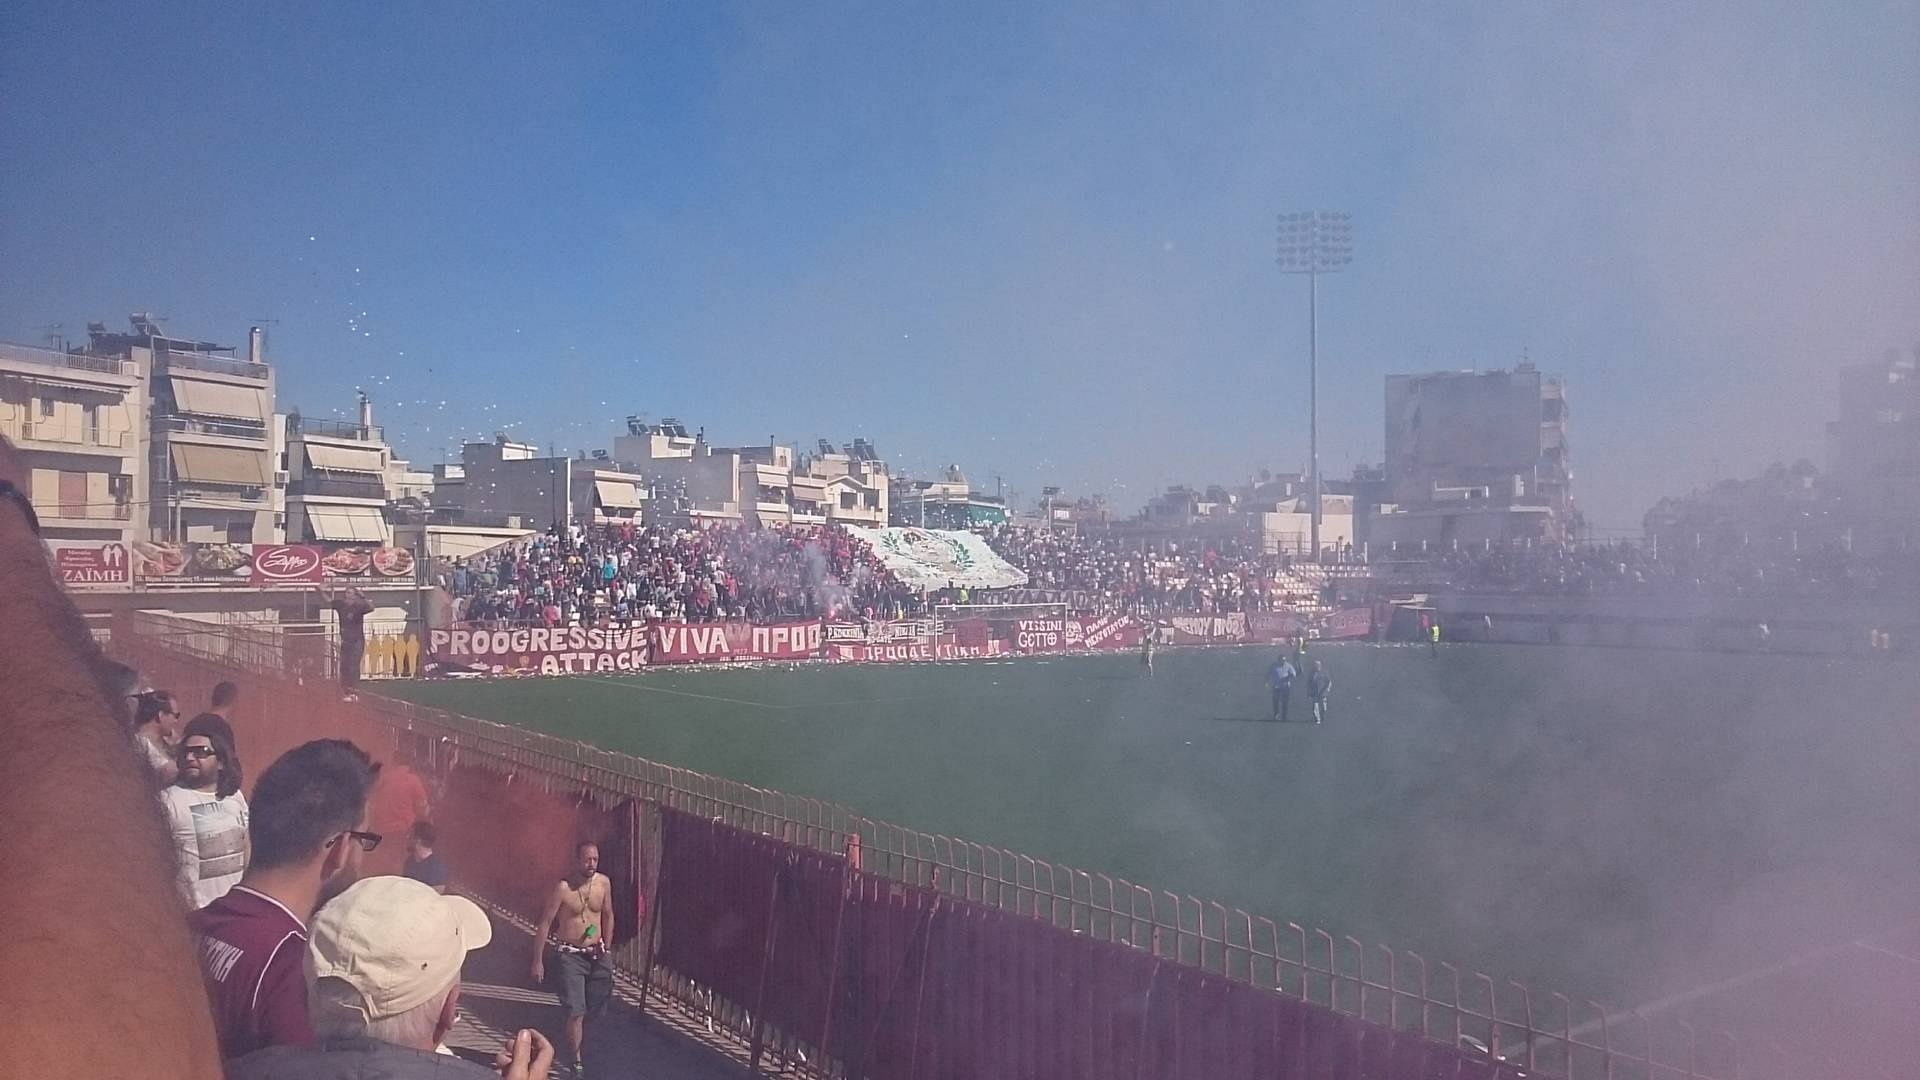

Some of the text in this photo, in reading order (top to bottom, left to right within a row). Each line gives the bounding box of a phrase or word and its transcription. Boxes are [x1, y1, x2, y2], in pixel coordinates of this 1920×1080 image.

[1019, 620, 1063, 631] VISSINI
[430, 626, 648, 655] PROOGRESSIVE
[659, 626, 730, 654] VIVA
[541, 648, 648, 675] ATTACK
